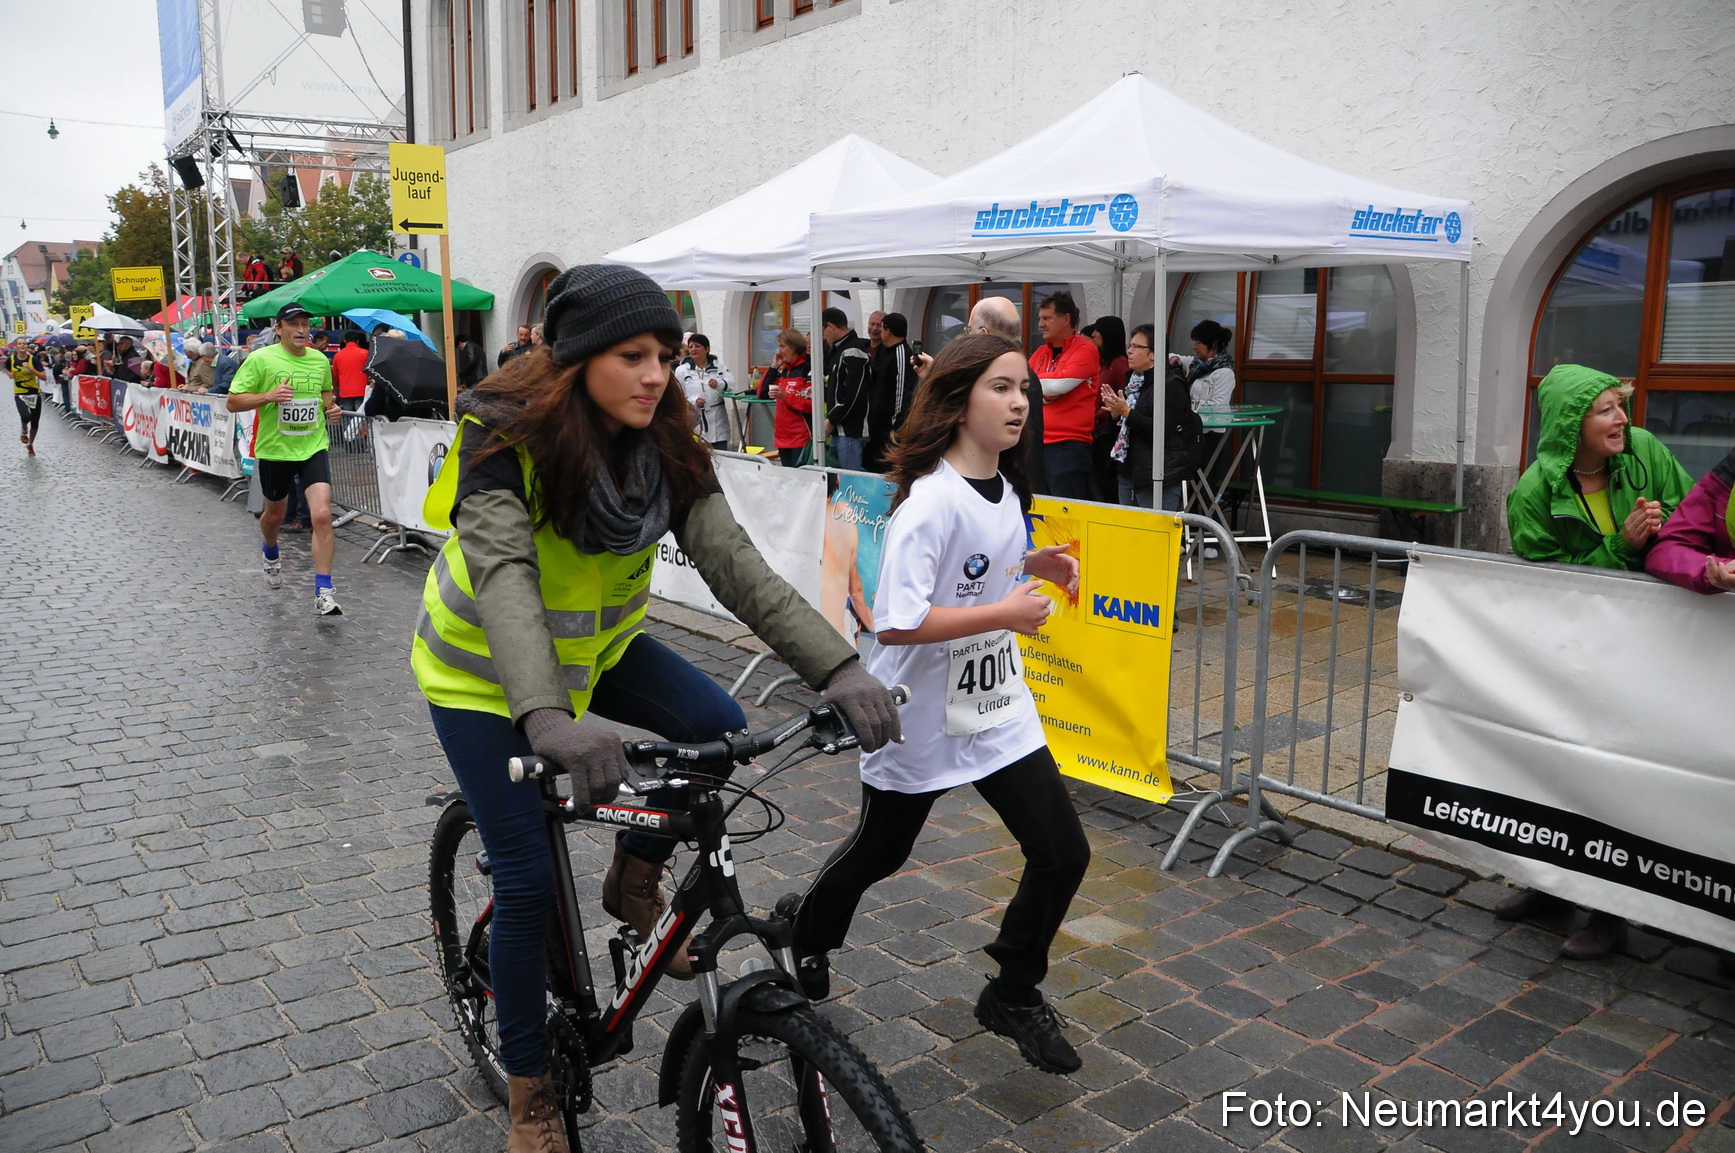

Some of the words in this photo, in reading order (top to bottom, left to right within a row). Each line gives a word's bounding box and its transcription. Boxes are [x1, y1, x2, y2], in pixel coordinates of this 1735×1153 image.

[393, 167, 444, 185] Jugend-
[408, 186, 431, 200] lauf
[973, 199, 1105, 230] slackstar
[1351, 205, 1443, 234] slackstar
[116, 277, 159, 285] Schnupper-
[78, 316, 91, 332] A
[283, 408, 315, 421] 5026
[1093, 593, 1160, 628] KANN
[952, 642, 982, 659] PARTL
[957, 639, 1017, 695] 4001
[977, 696, 1011, 715] Linda
[1077, 753, 1160, 787] www.kann.de
[596, 808, 661, 829] ANALOG
[1423, 796, 1574, 856] Leistungen,
[1584, 839, 1629, 867] die
[1637, 855, 1735, 905] verbin
